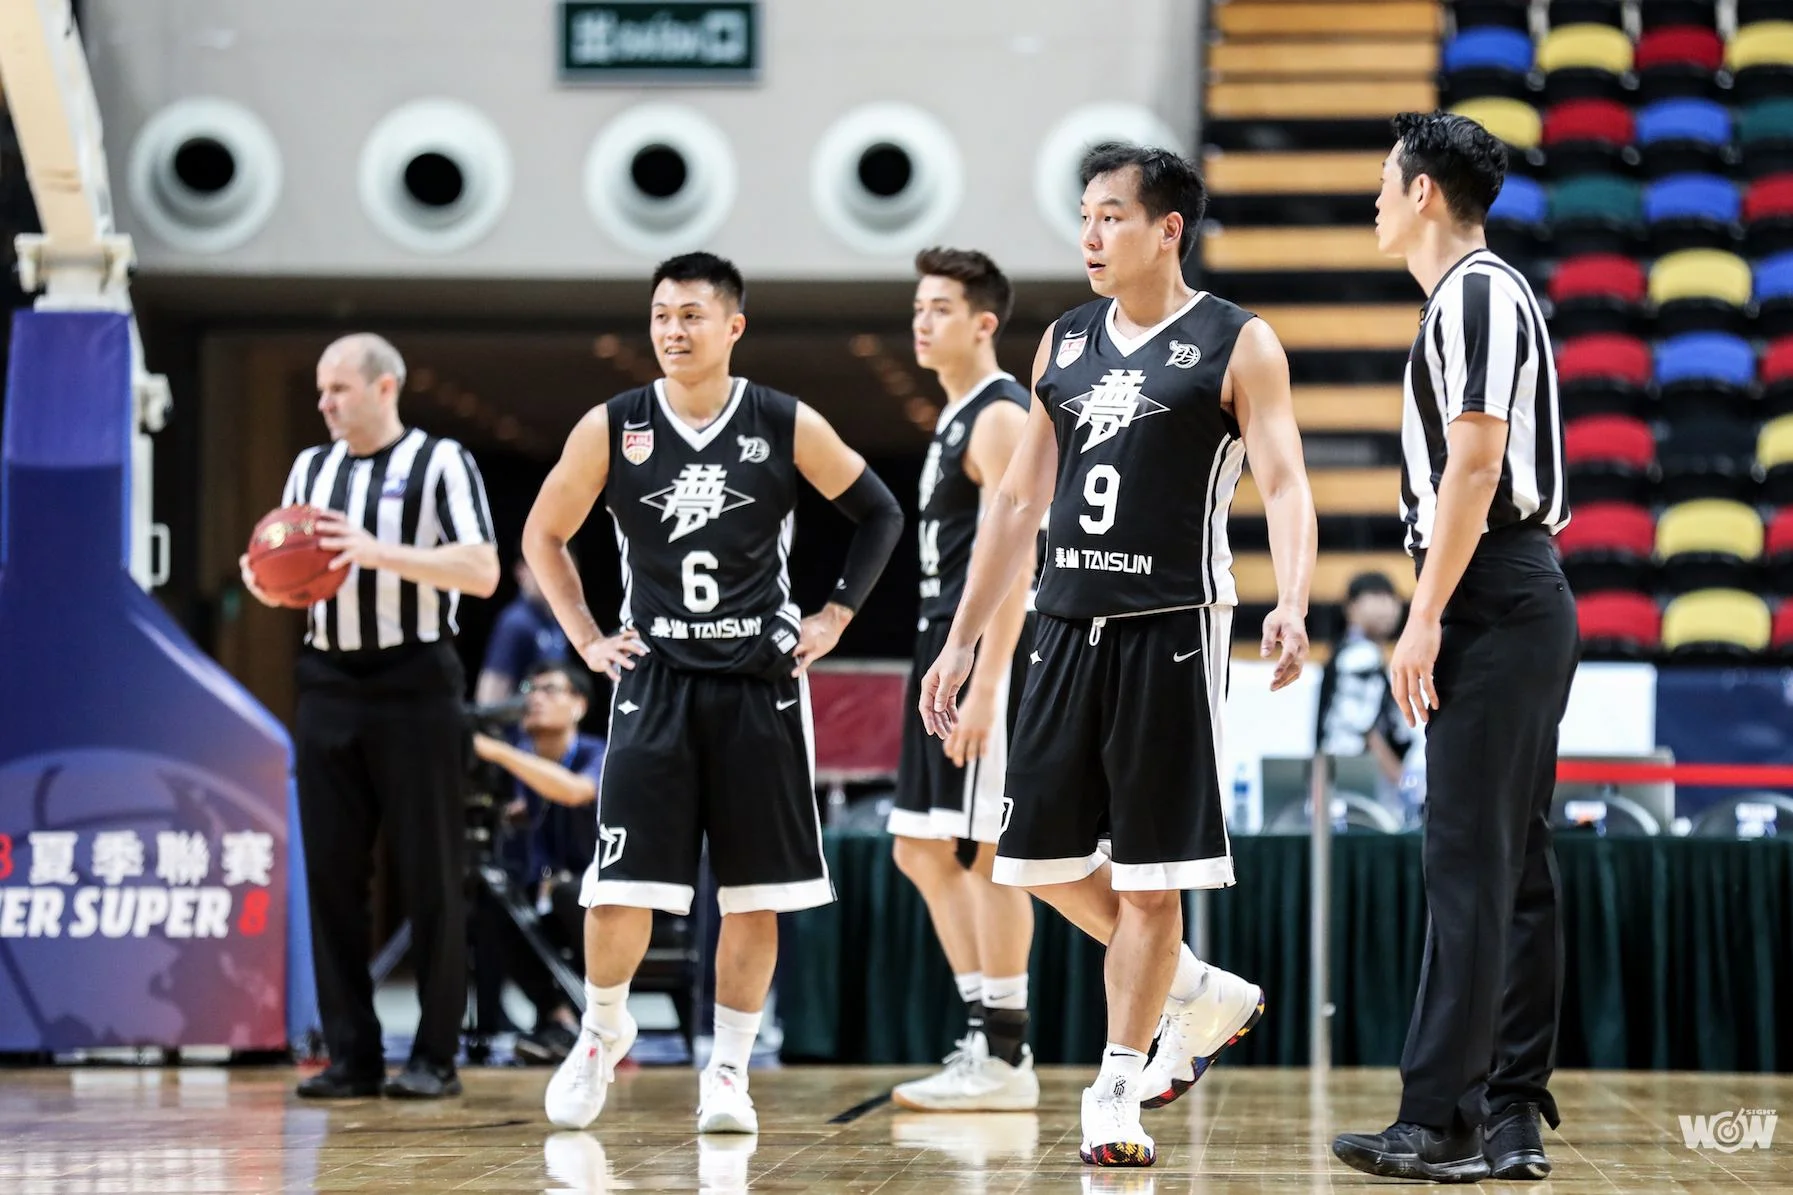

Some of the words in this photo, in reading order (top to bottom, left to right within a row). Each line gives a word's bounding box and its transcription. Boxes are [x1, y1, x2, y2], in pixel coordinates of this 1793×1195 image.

[1079, 464, 1121, 535] 9
[682, 551, 719, 613] 6
[1081, 549, 1152, 575] TAISUN
[690, 616, 762, 639] TAISUN
[28, 830, 274, 886] 夏季聯賽
[0, 887, 65, 938] ER
[68, 887, 232, 938] SUPER
[237, 888, 270, 936] 8
